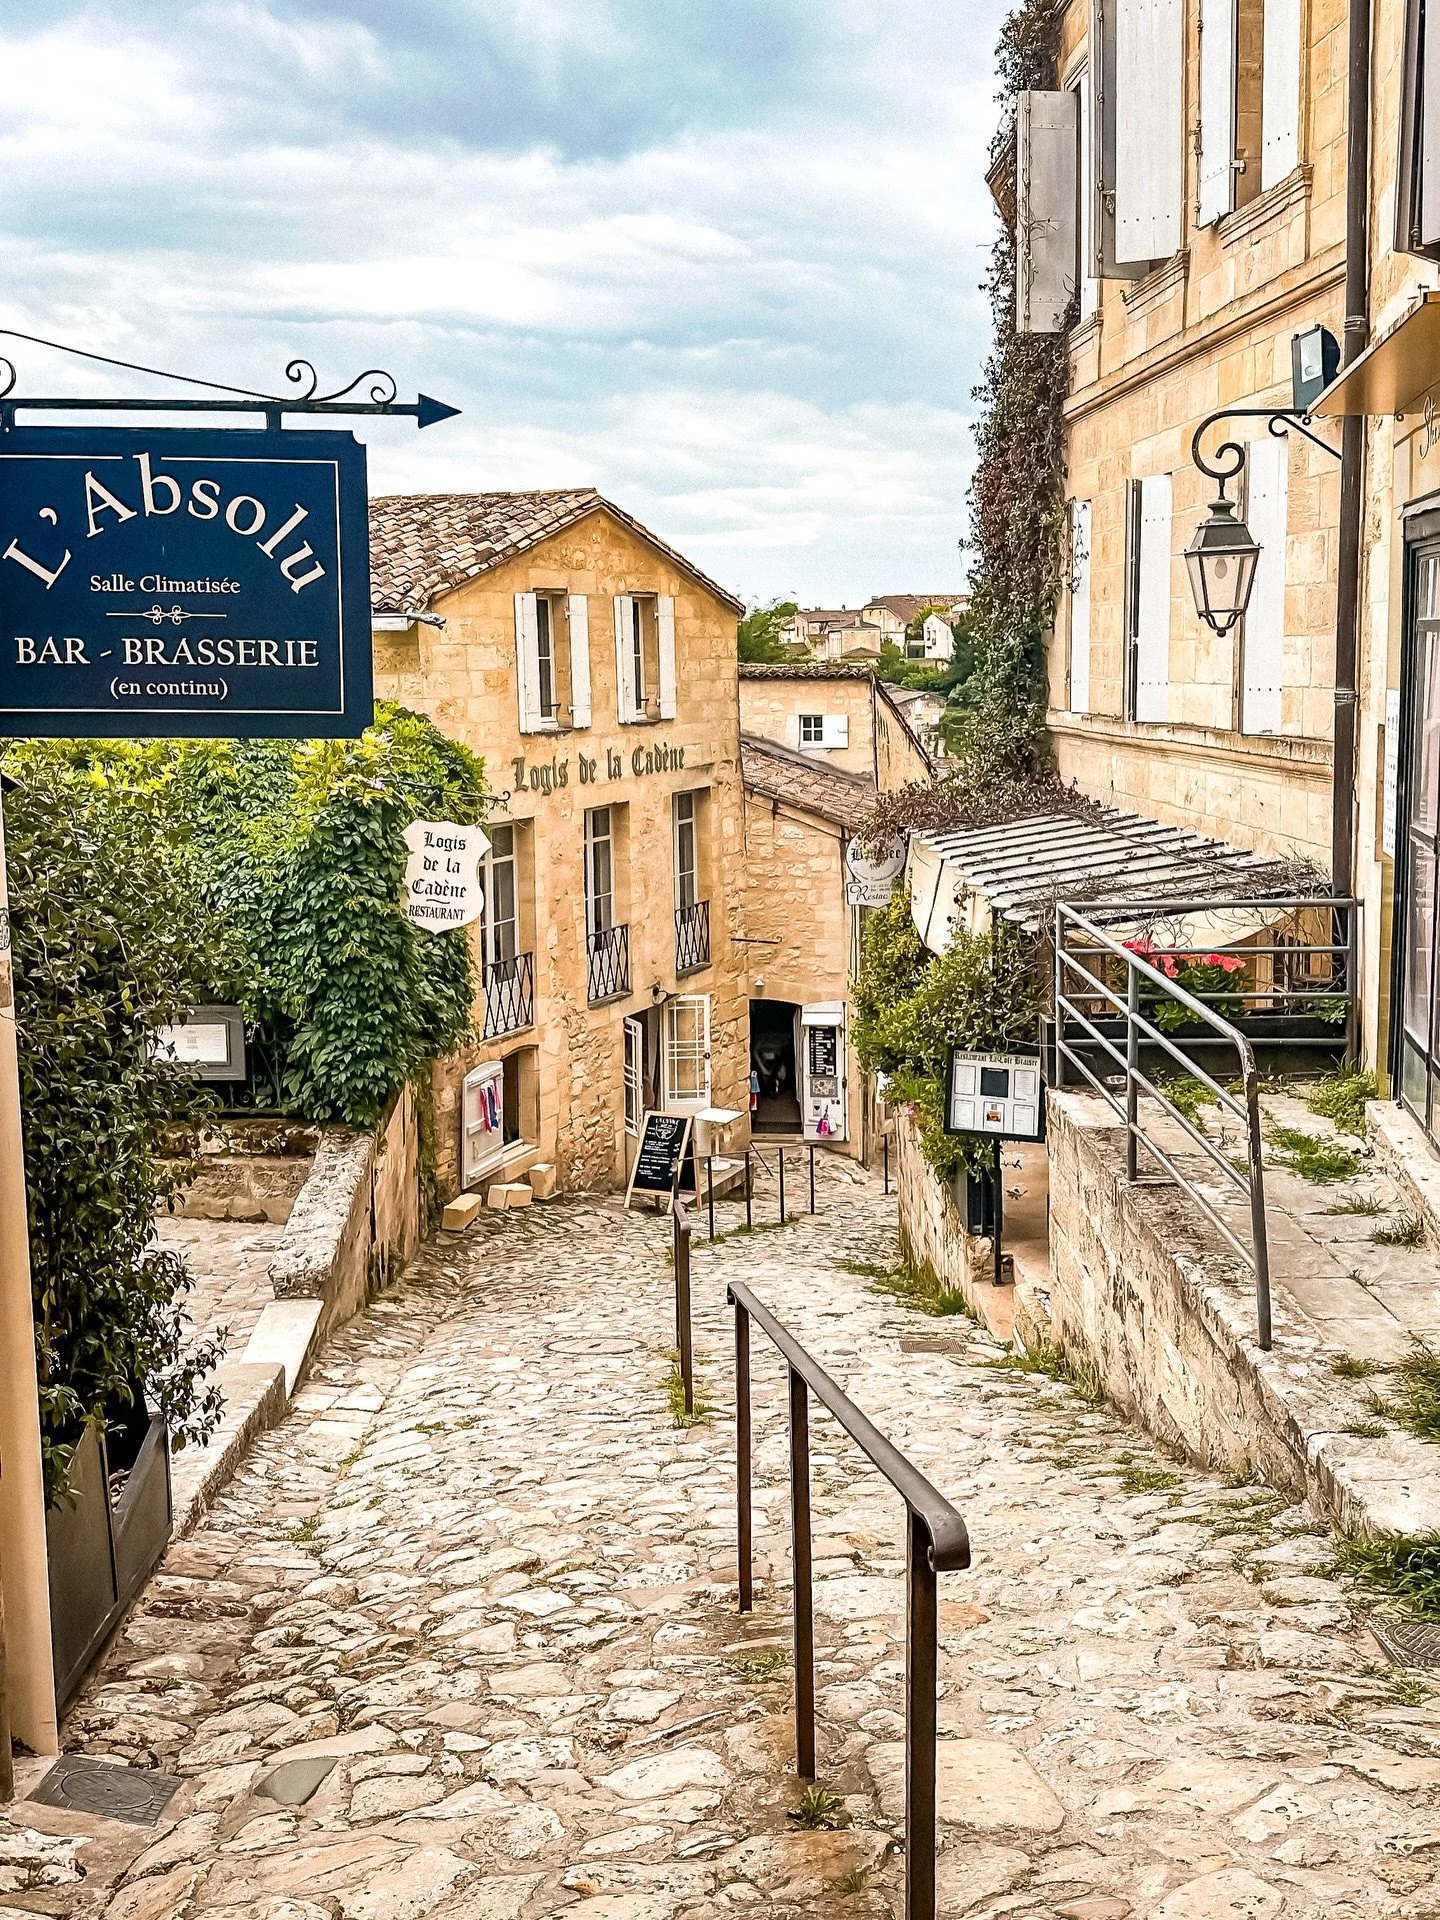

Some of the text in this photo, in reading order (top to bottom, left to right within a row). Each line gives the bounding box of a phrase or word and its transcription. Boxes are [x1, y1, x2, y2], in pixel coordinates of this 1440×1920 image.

[2, 452, 326, 594] L'Absolu
[90, 574, 241, 594] Salle Climatisée
[15, 637, 91, 664] BAR
[121, 638, 320, 667] BRASSERIE
[110, 676, 228, 699] (en continu)
[511, 742, 685, 796] Logis de la Cadène
[424, 831, 467, 852] Logis
[423, 855, 461, 874] de la
[412, 878, 466, 898] Cadène
[408, 904, 465, 920] RESTAURANT
[955, 1051, 987, 1062] Restaurant
